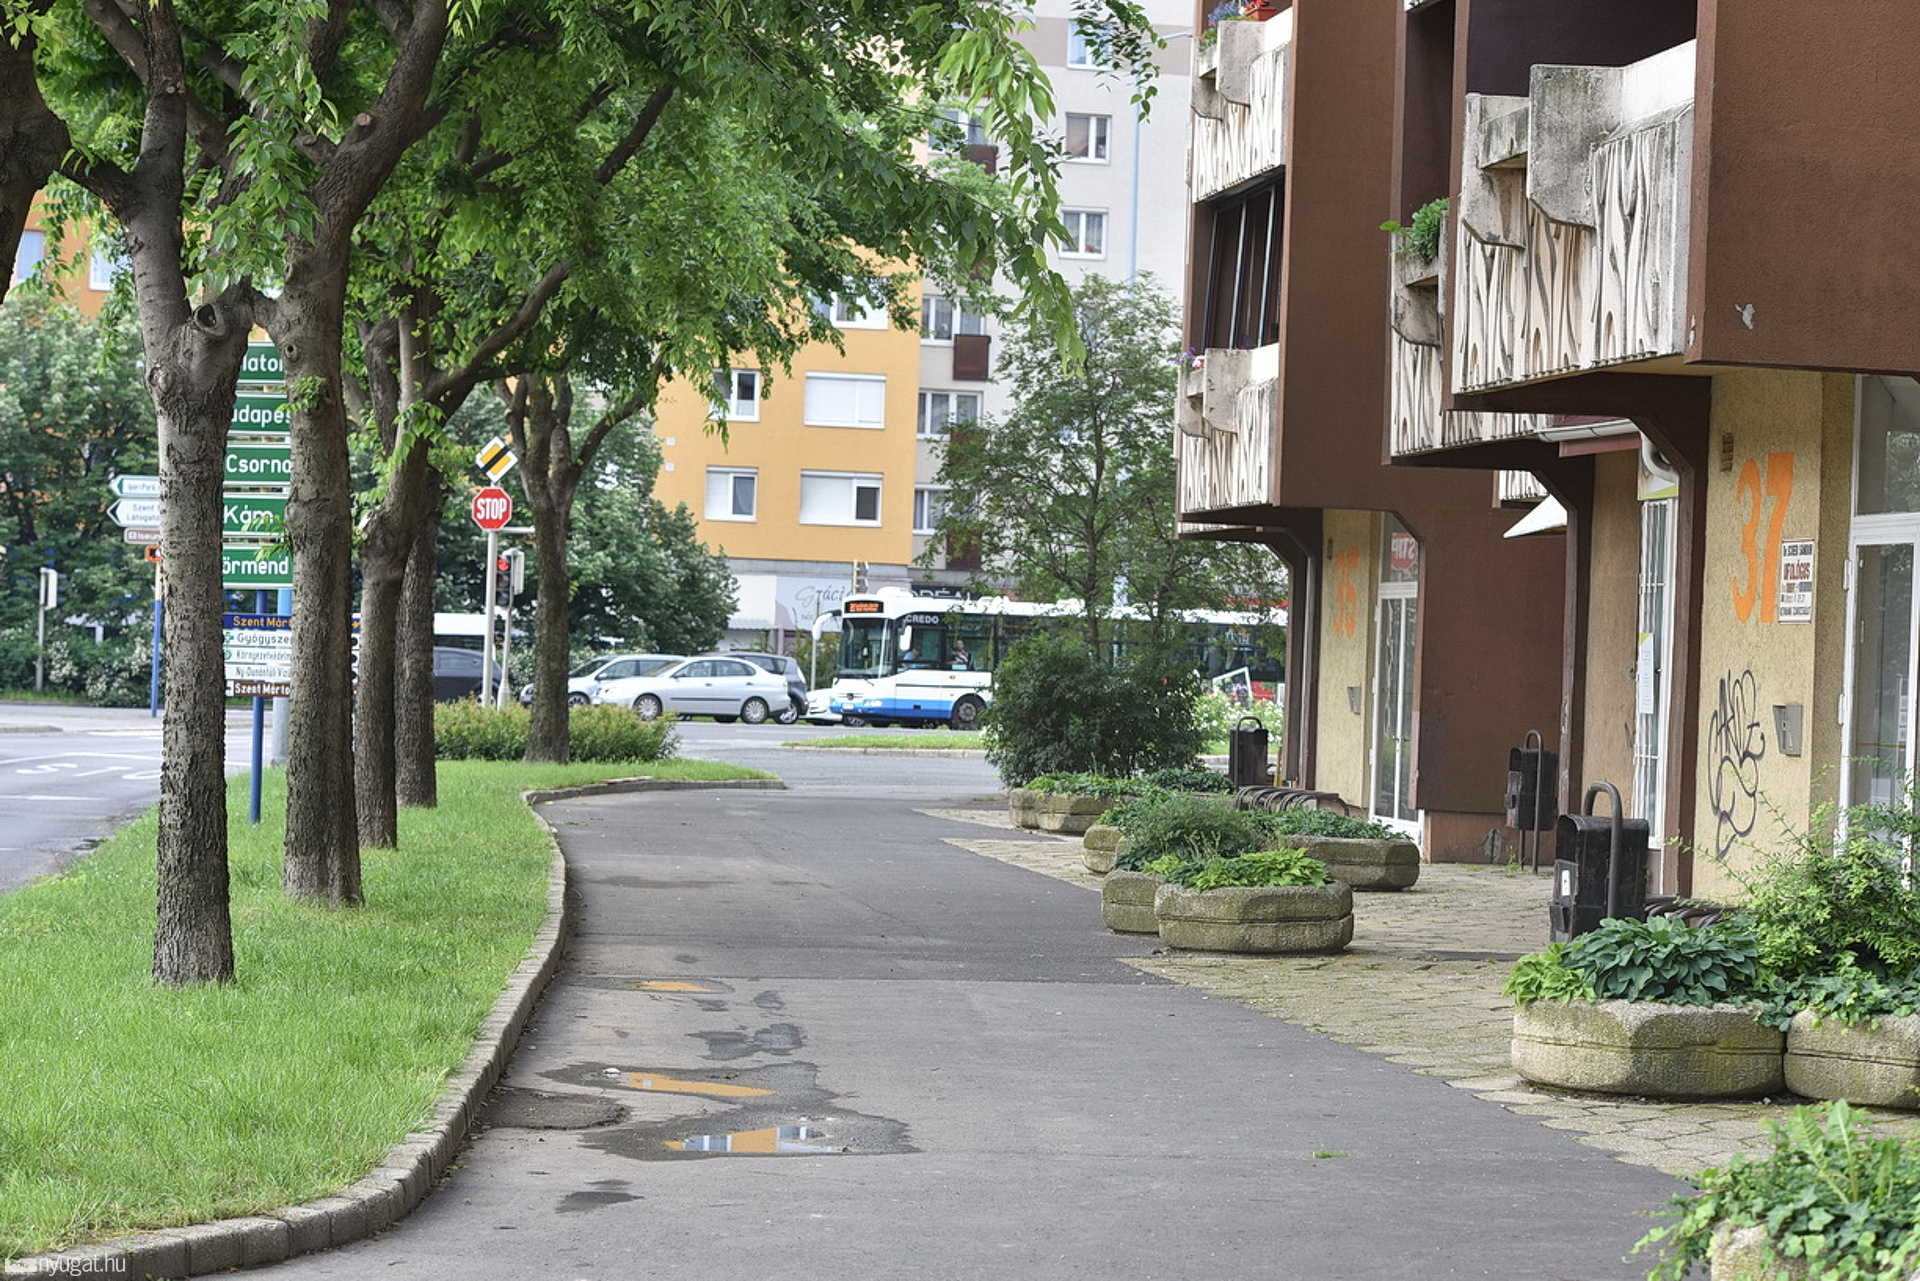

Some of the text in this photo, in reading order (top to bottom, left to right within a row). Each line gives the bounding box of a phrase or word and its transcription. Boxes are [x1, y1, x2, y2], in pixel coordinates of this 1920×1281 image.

[476, 497, 508, 521] STOP
[1732, 451, 1794, 624] 37
[222, 556, 289, 576] örmend
[233, 615, 265, 627] Szent
[905, 613, 940, 625] CREDO
[237, 632, 291, 645] Gyógysze
[235, 683, 292, 695] Szent Márto
